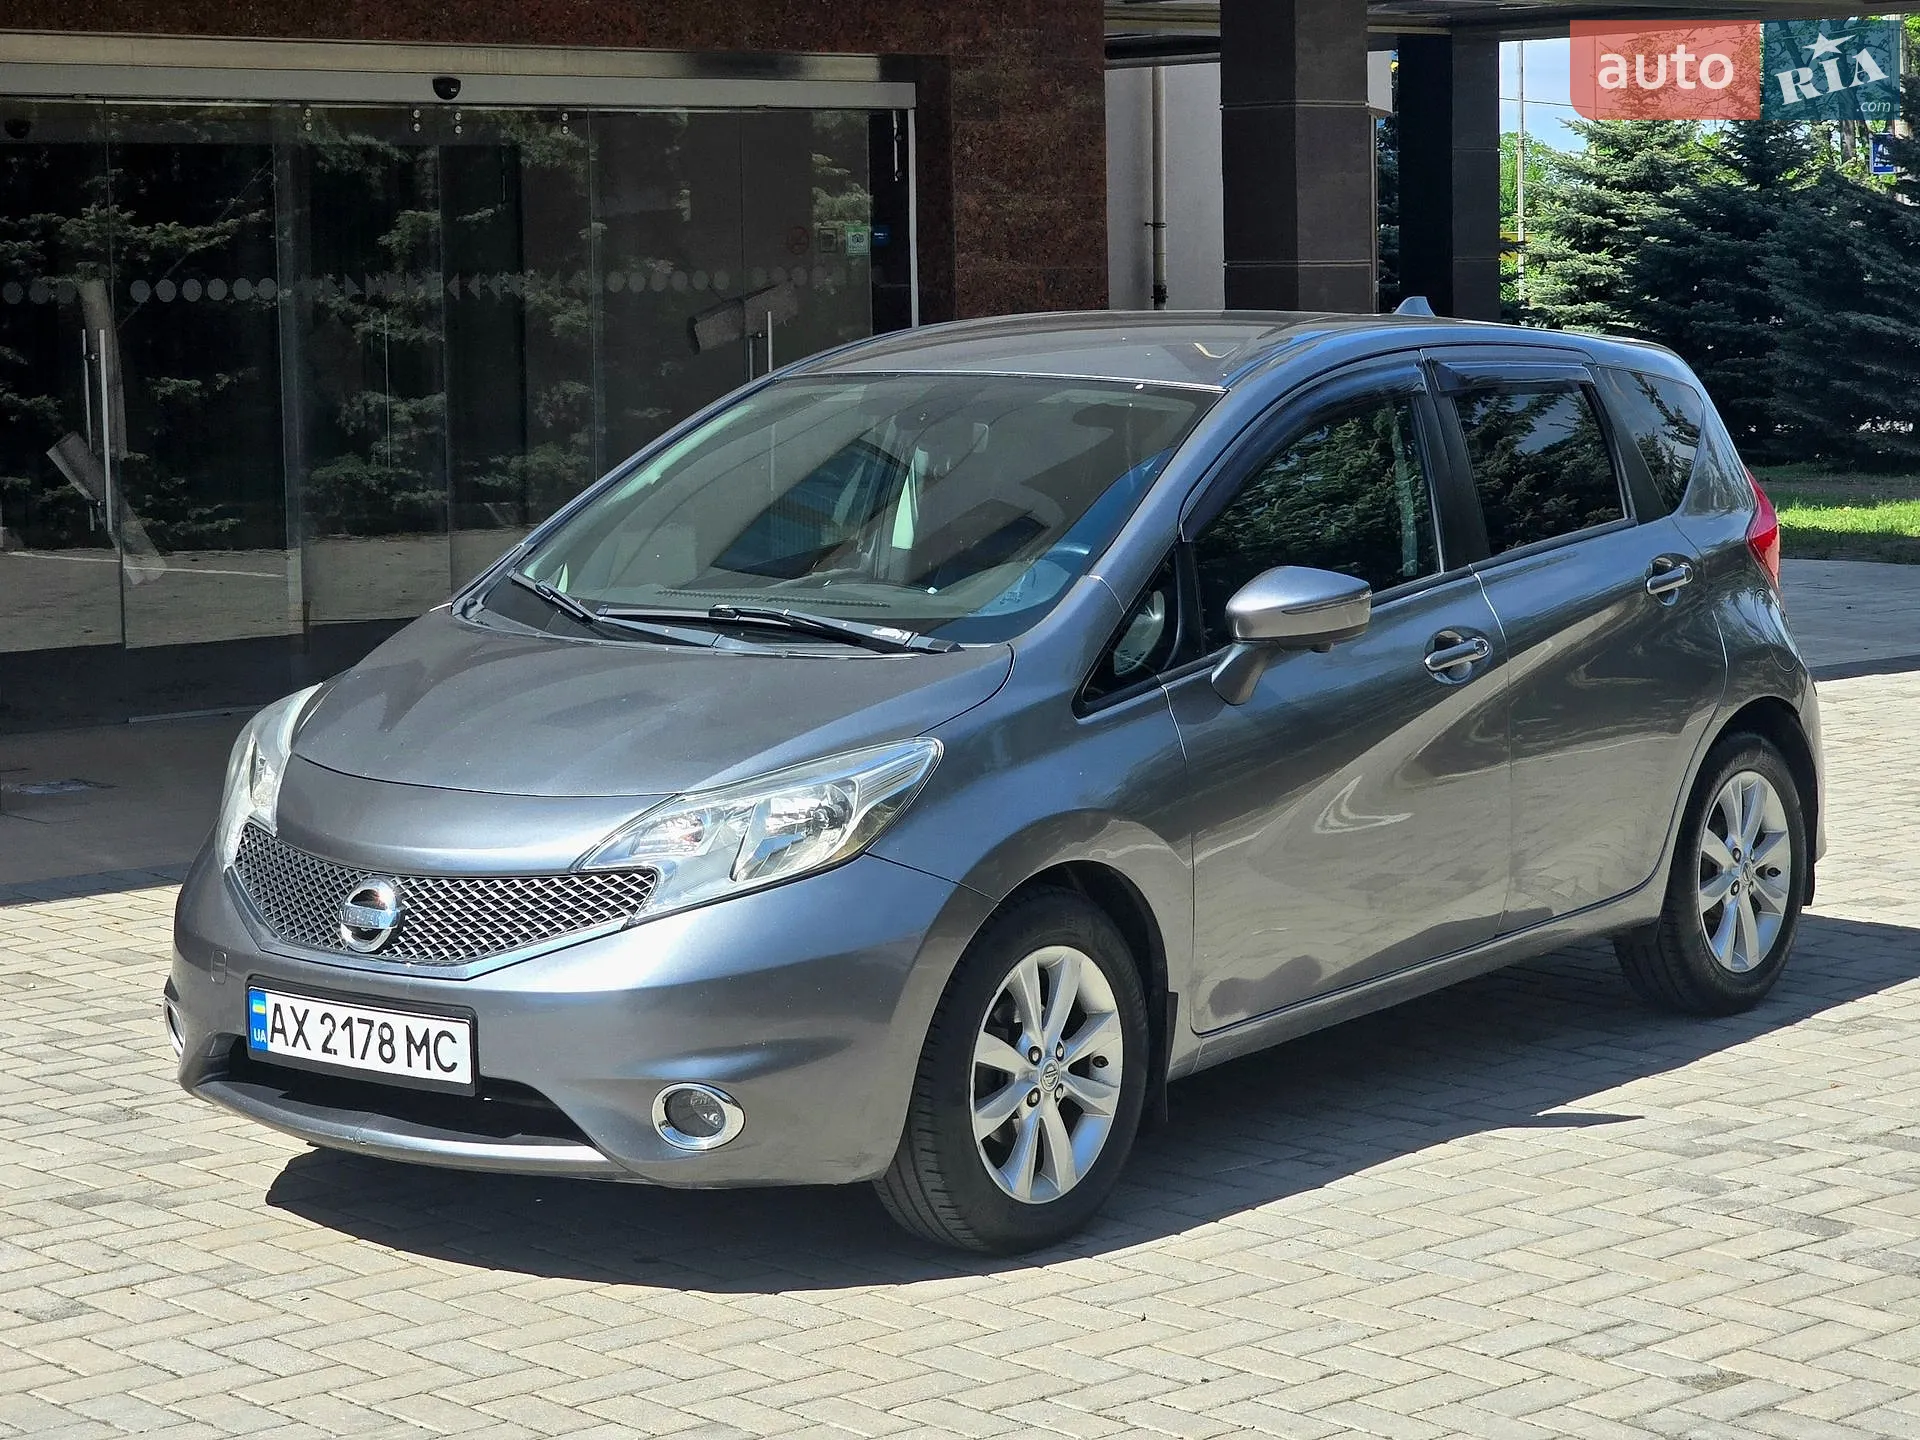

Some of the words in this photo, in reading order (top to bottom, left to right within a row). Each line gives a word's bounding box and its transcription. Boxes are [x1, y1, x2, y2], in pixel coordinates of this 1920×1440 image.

[253, 1028, 267, 1042] UA
[269, 1003, 311, 1050] AX
[320, 1012, 396, 1063] 2178
[406, 1024, 457, 1072] MC
